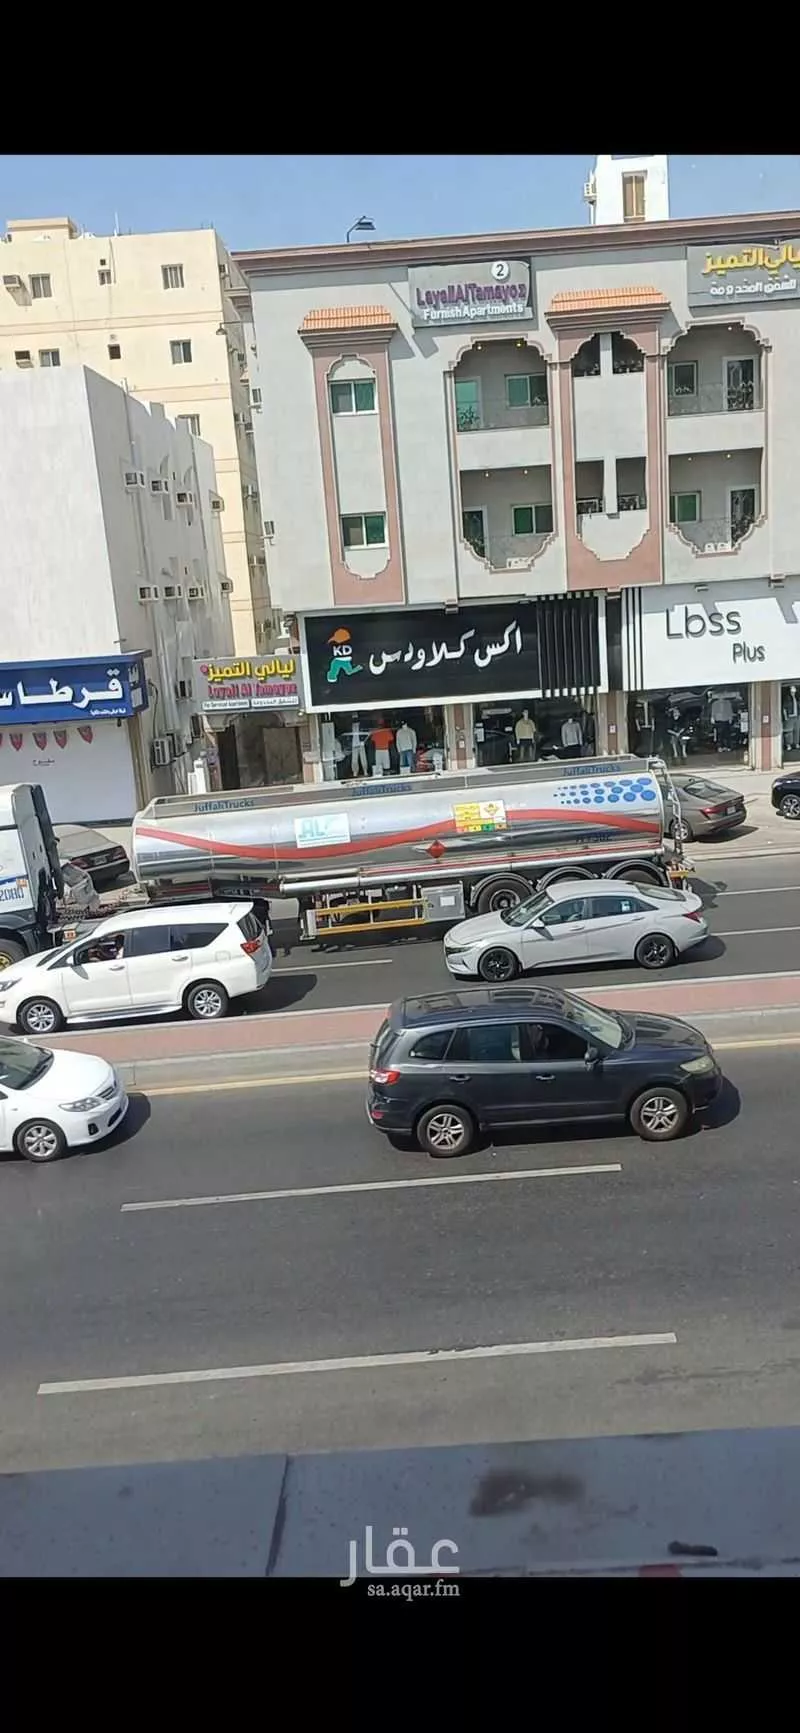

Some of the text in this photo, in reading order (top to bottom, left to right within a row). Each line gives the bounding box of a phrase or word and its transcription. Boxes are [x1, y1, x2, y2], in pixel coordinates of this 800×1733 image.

[496, 263, 505, 277] 2
[665, 605, 742, 639] Lbss
[333, 645, 353, 657] KD
[732, 641, 766, 664] Plus
[208, 659, 296, 682] ليالي التميز
